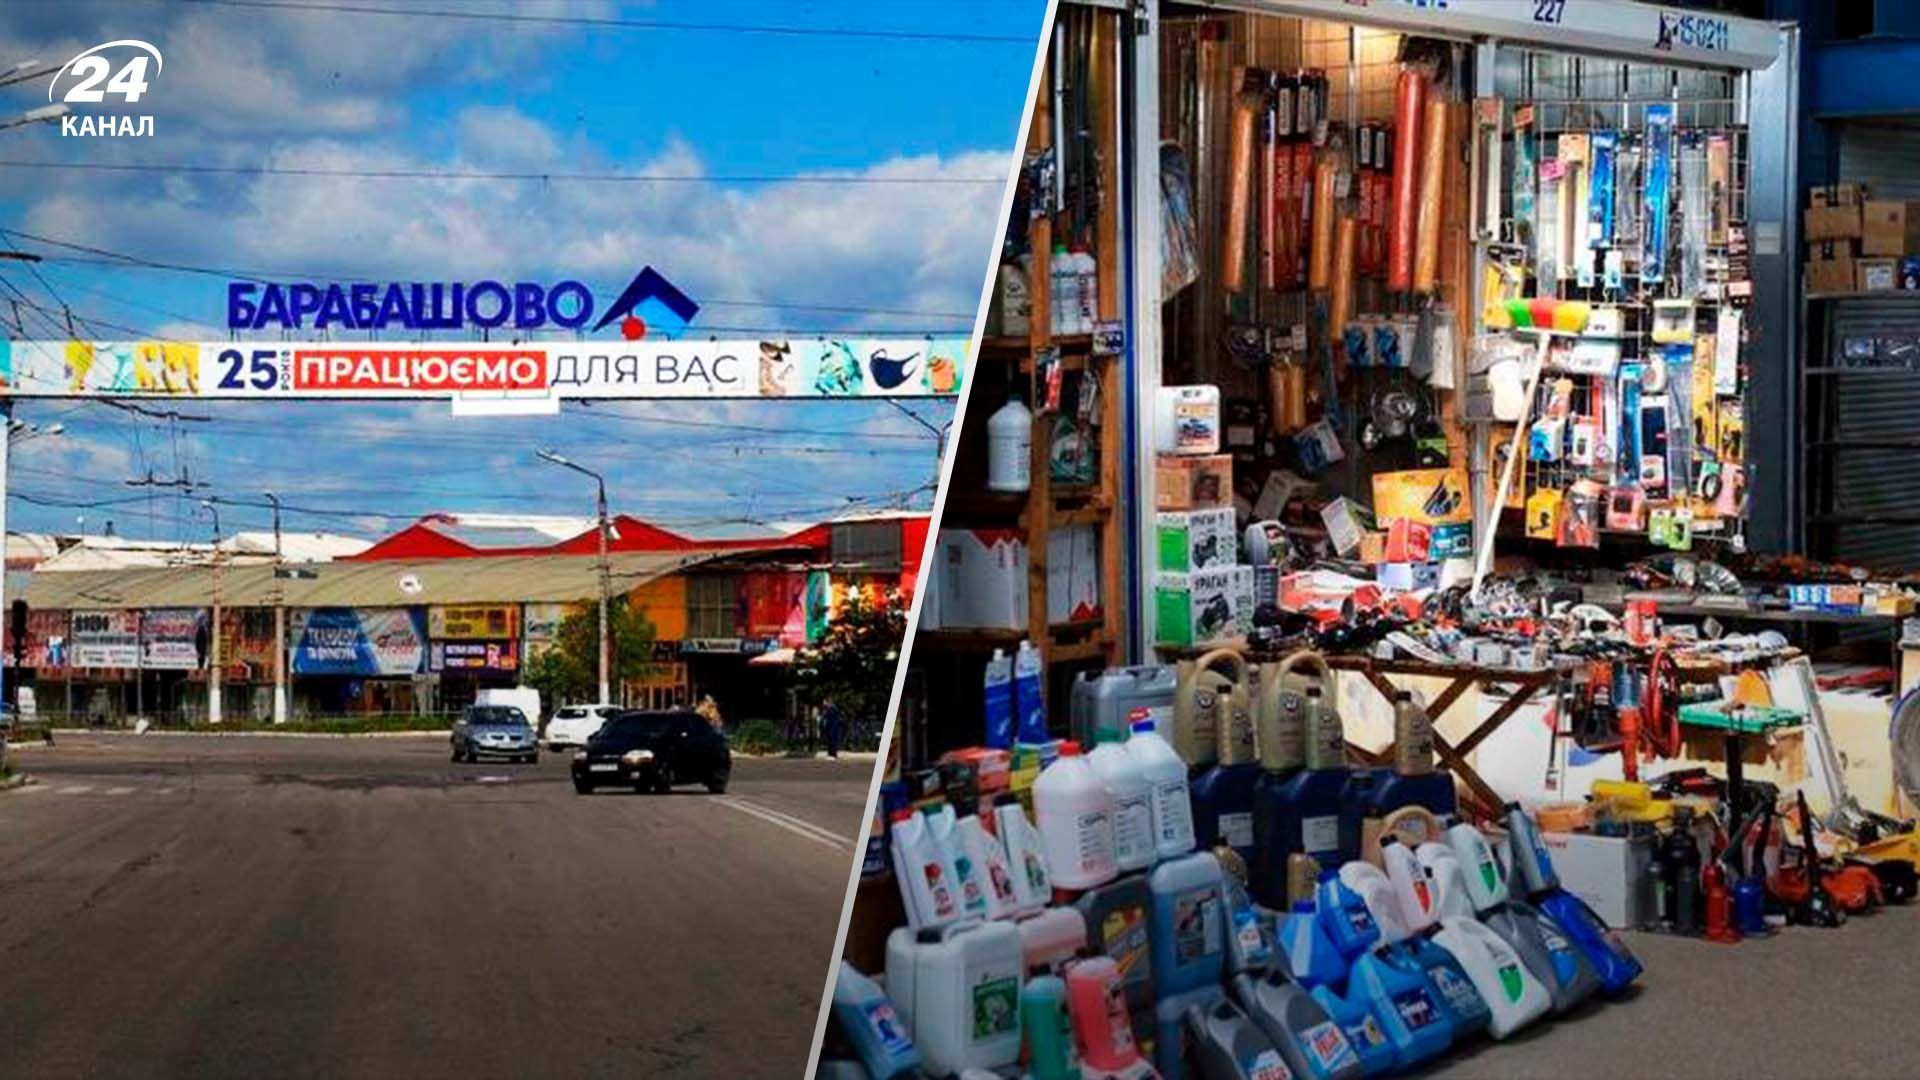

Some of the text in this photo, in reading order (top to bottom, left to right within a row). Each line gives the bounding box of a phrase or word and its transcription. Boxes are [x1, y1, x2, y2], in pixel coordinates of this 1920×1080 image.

[1533, 0, 1566, 24] 227
[228, 280, 594, 330] БАРАБАШОВО
[217, 349, 278, 391] 25
[300, 356, 539, 387] ПРАЦЮЄМО
[551, 355, 638, 387] ДЛЯ
[656, 355, 739, 384] ВАС
